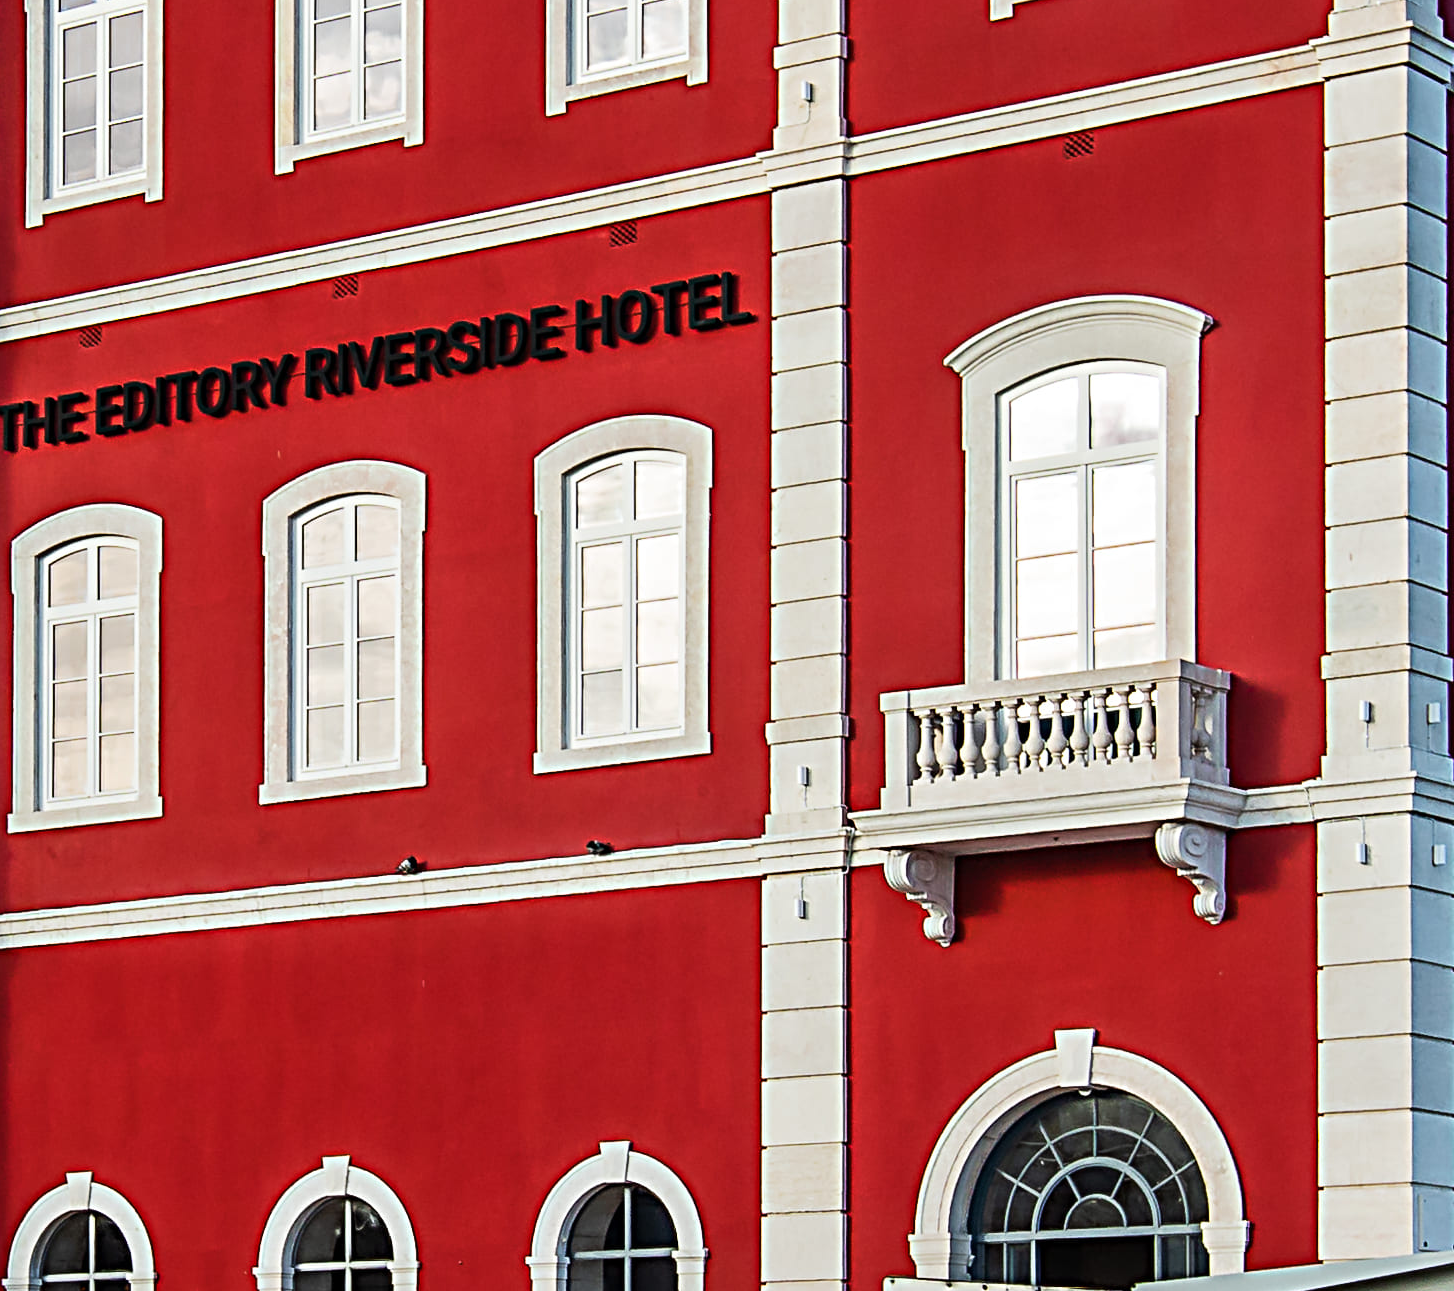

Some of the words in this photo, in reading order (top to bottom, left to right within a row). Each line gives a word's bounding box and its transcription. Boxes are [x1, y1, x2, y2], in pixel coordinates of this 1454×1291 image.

[94, 352, 298, 436] EDITORY
[304, 305, 567, 400] RIVERSIDE
[575, 271, 757, 352] HOTEL
